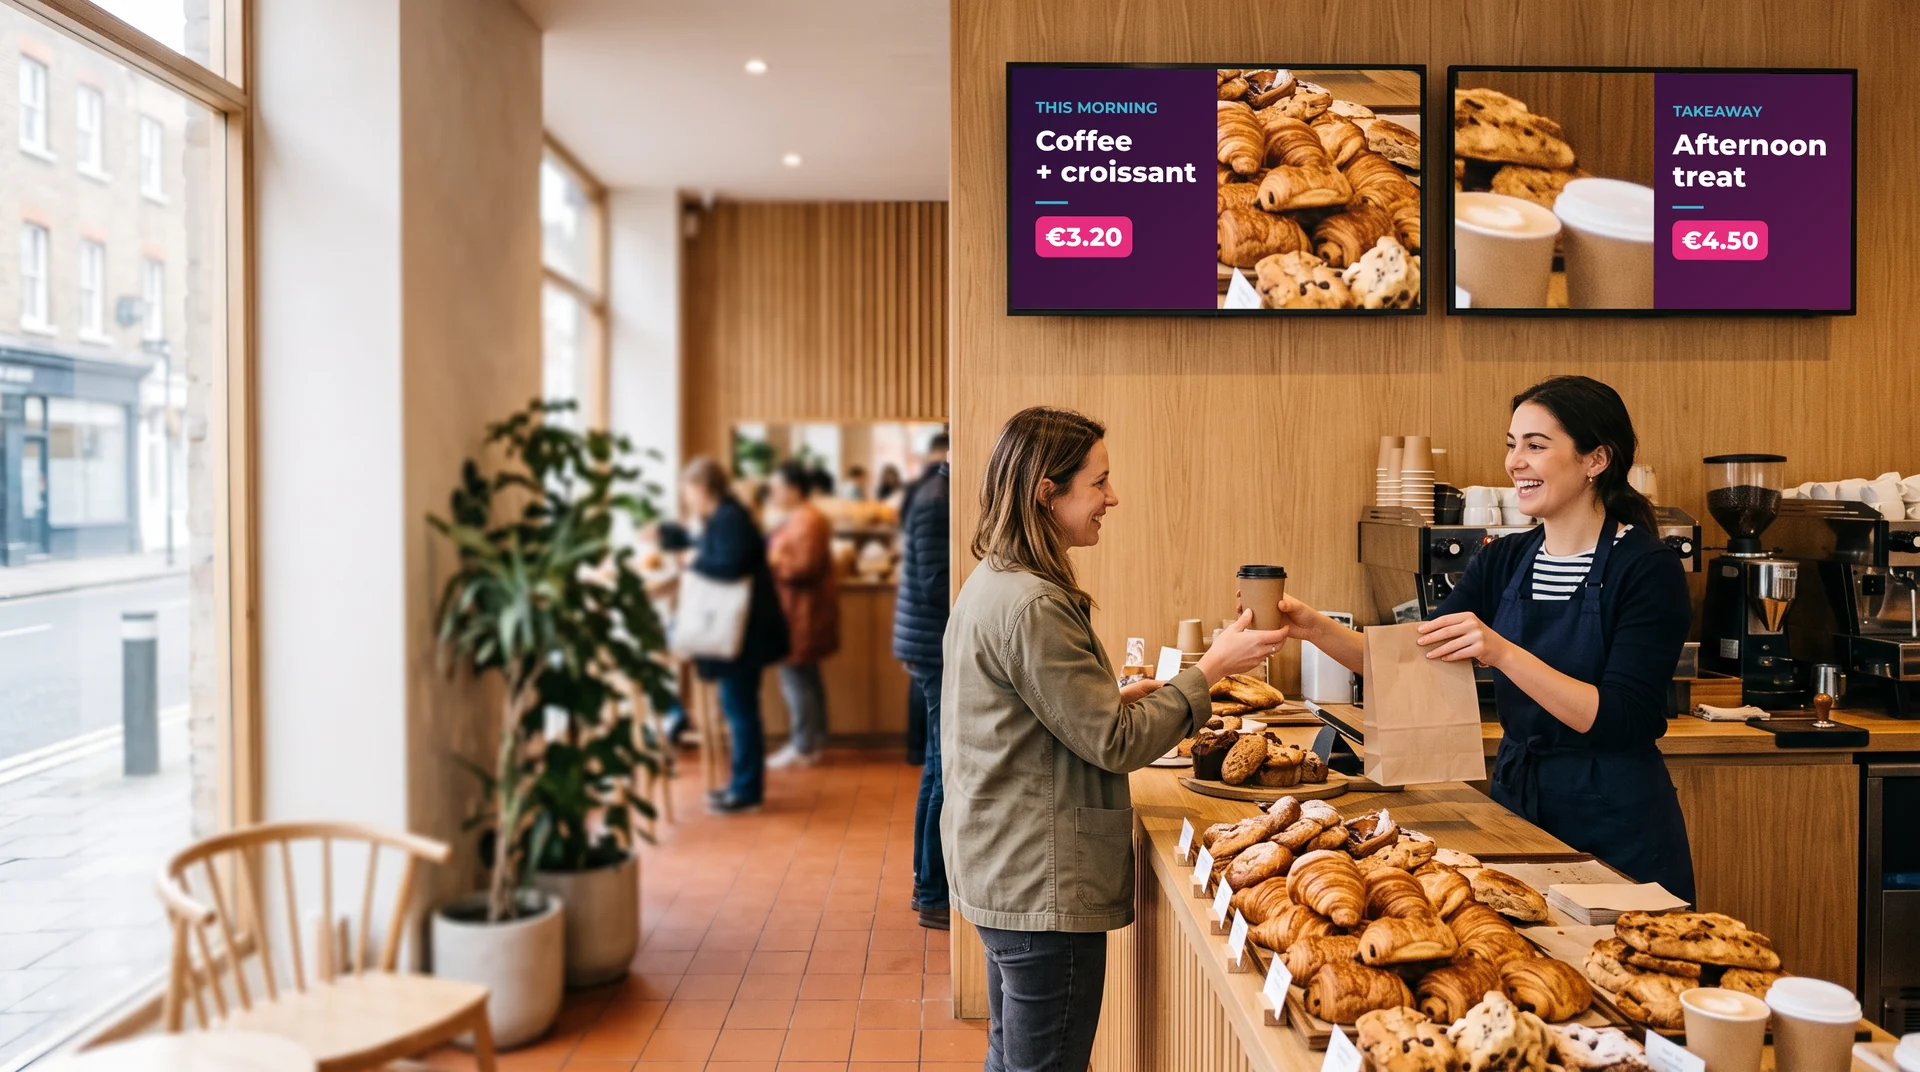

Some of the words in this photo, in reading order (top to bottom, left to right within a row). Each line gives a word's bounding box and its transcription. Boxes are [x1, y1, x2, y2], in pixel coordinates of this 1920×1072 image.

[1035, 101, 1073, 114] THIS
[1078, 101, 1158, 114] MORNING
[1672, 105, 1763, 118] TAKEAWAY
[1036, 129, 1133, 152] Coffee
[1672, 133, 1827, 156] Afternoon
[1036, 164, 1052, 180] +
[1061, 159, 1197, 183] croissant
[1672, 166, 1747, 188] treat
[1045, 227, 1123, 247] €3.20
[1682, 231, 1759, 251] €4.50
